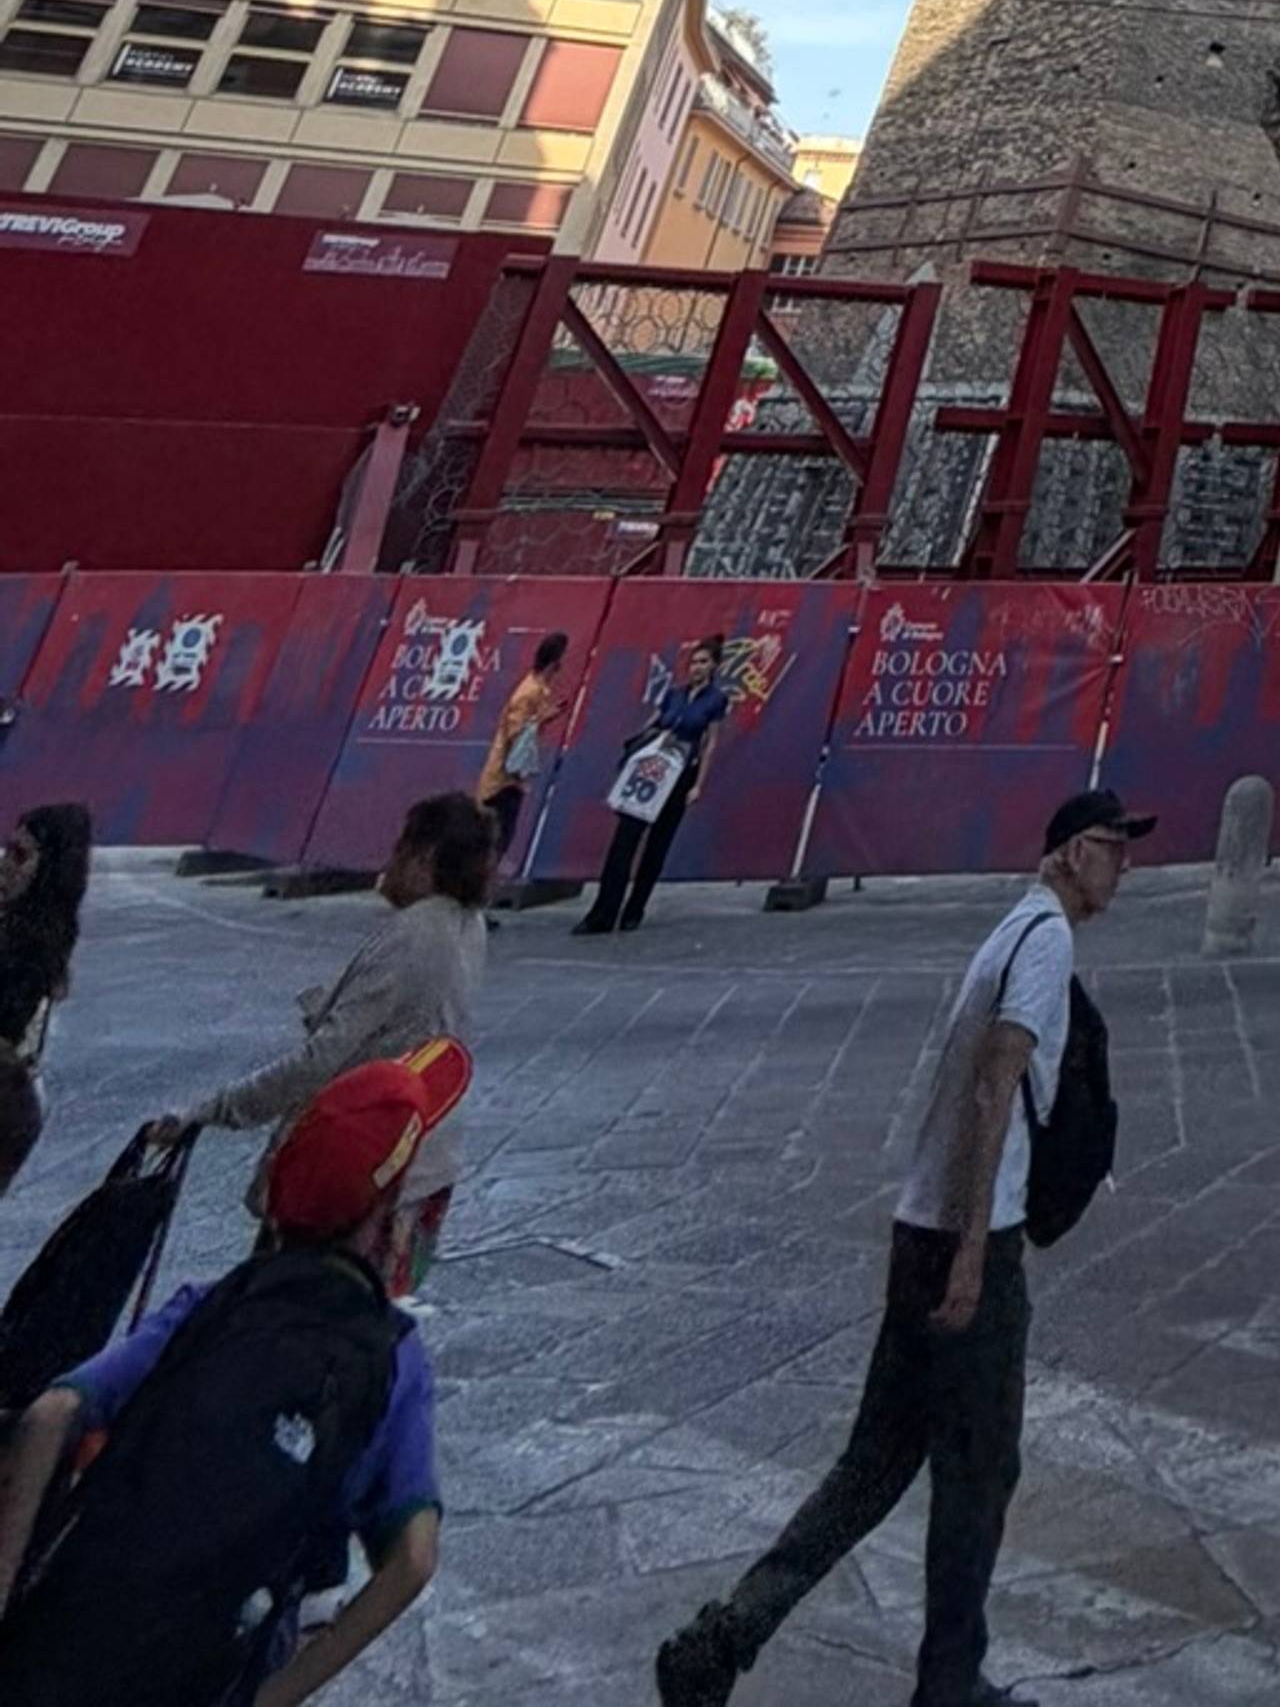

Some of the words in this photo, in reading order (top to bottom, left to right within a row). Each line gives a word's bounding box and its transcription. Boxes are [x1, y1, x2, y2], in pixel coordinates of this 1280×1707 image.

[871, 649, 1007, 677] BOLOGNA
[863, 681, 883, 706] A
[891, 680, 990, 706] CUORE
[368, 704, 462, 731] APERTO
[854, 710, 968, 737] APERTO
